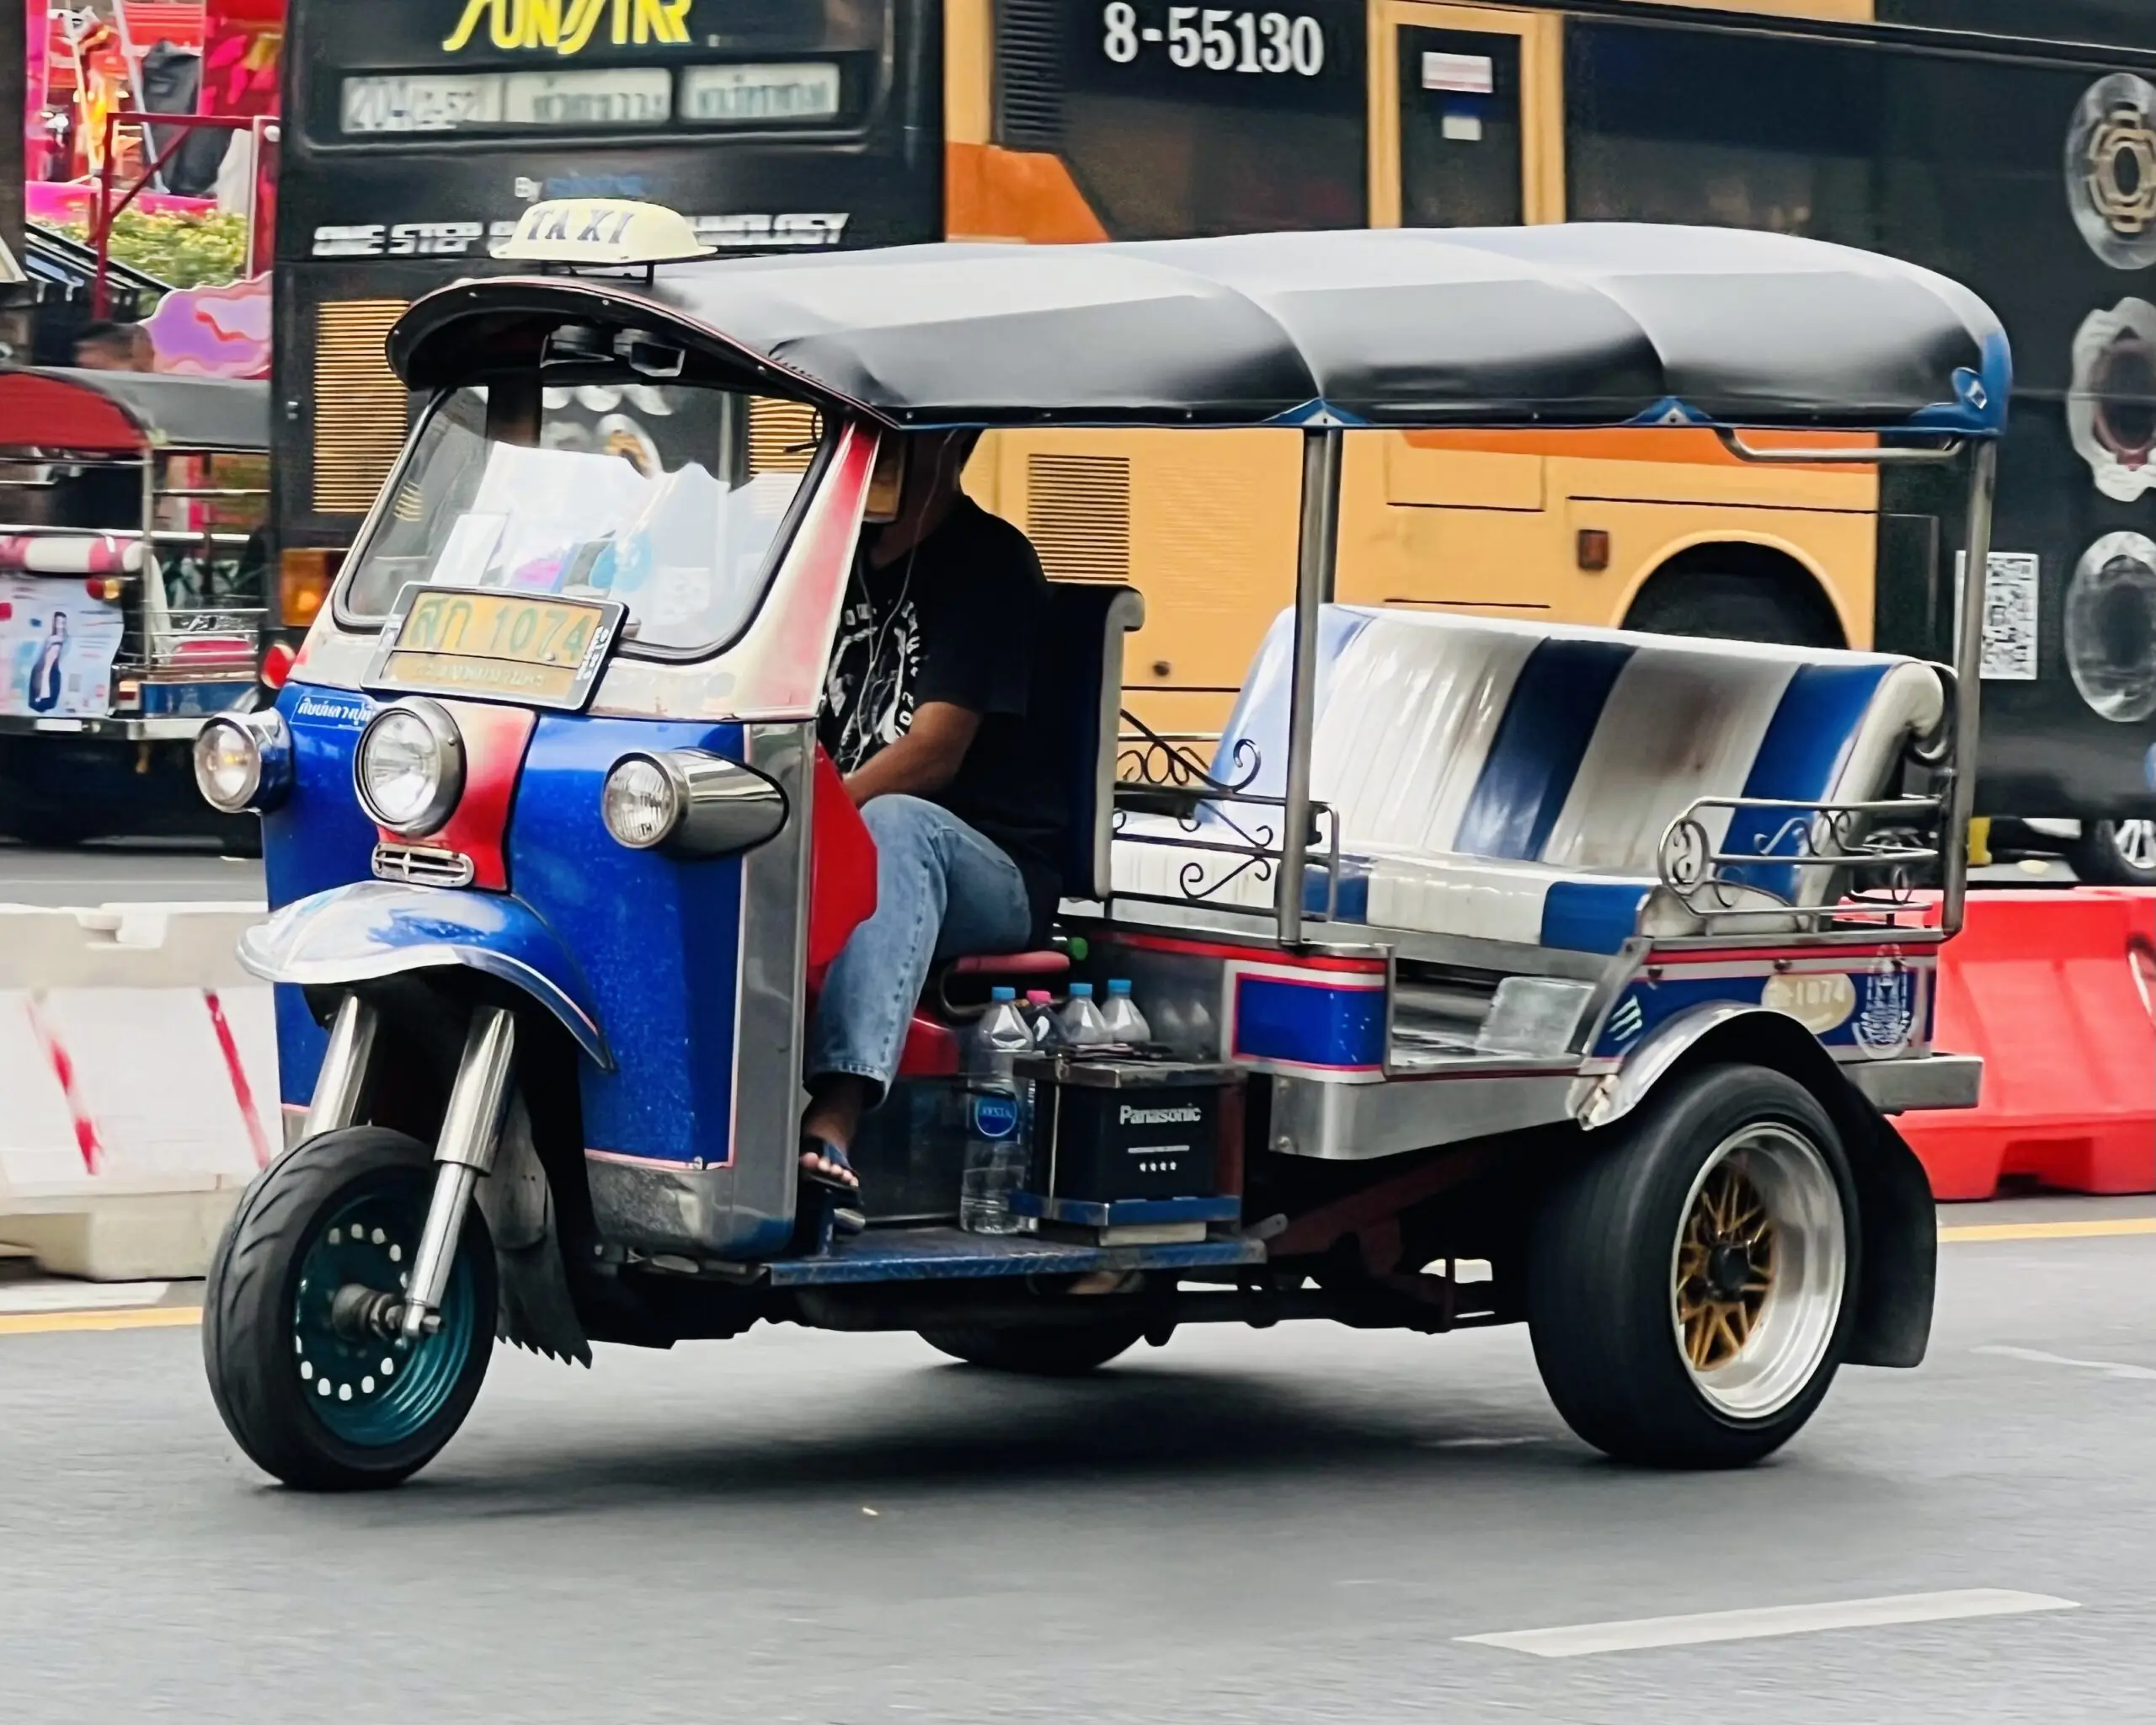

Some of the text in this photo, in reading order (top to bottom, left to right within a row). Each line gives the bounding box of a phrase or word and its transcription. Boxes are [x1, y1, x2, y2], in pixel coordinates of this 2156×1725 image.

[1103, 2, 1324, 76] 8-55130
[388, 222, 483, 254] STEP
[527, 209, 634, 243] TAXI
[491, 604, 592, 662] 1074
[1120, 1102, 1202, 1124] Panasonic
